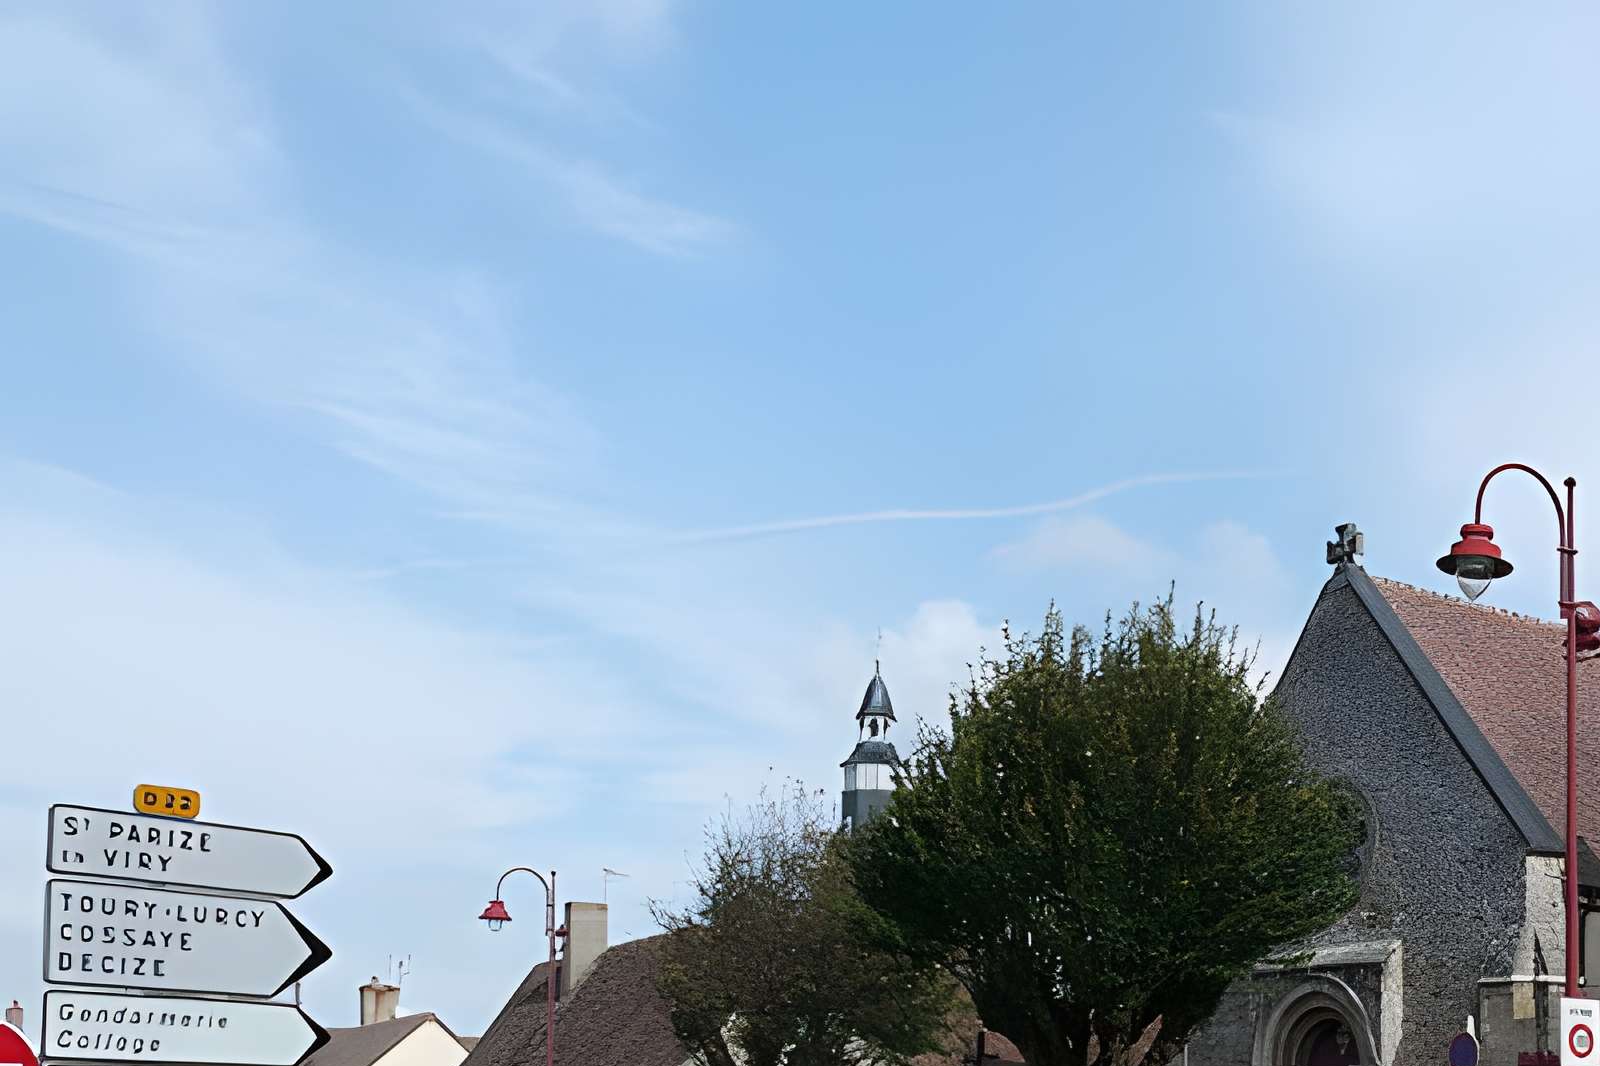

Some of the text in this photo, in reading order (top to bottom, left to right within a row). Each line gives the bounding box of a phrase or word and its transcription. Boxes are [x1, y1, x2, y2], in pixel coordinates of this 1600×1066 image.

[143, 791, 157, 806] D
[109, 822, 211, 852] PARIZE
[104, 849, 172, 872] VIRY
[60, 924, 192, 951] COSSAYE
[58, 952, 165, 977] DECIZE
